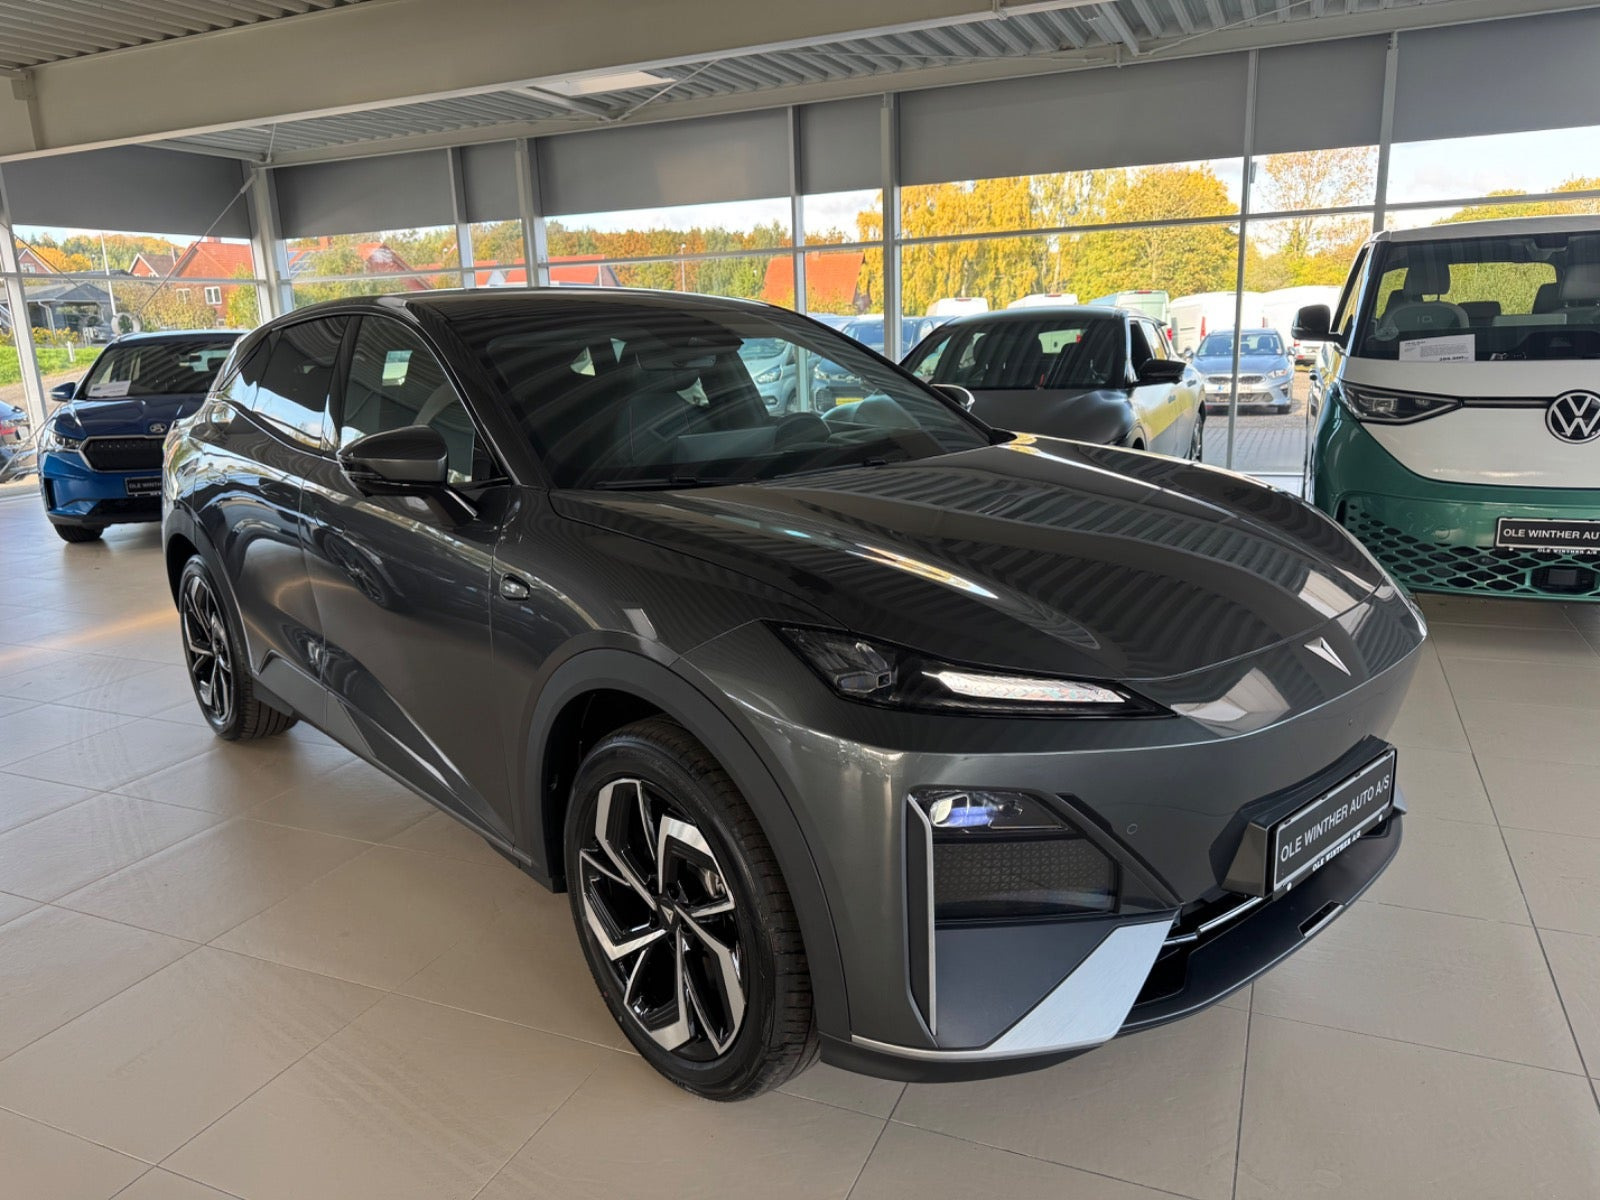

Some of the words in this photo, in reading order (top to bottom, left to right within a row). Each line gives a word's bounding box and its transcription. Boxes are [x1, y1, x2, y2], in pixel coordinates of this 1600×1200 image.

[1503, 528, 1526, 538] OLE
[1528, 529, 1580, 539] WINTHER
[1582, 530, 1600, 540] AU
[1280, 836, 1302, 862] OLE
[1304, 804, 1348, 846] WINTHER
[1350, 786, 1375, 815] AUTO
[1375, 774, 1390, 796] A/S
[1312, 856, 1325, 872] OLE
[1325, 837, 1351, 862] WINTHER
